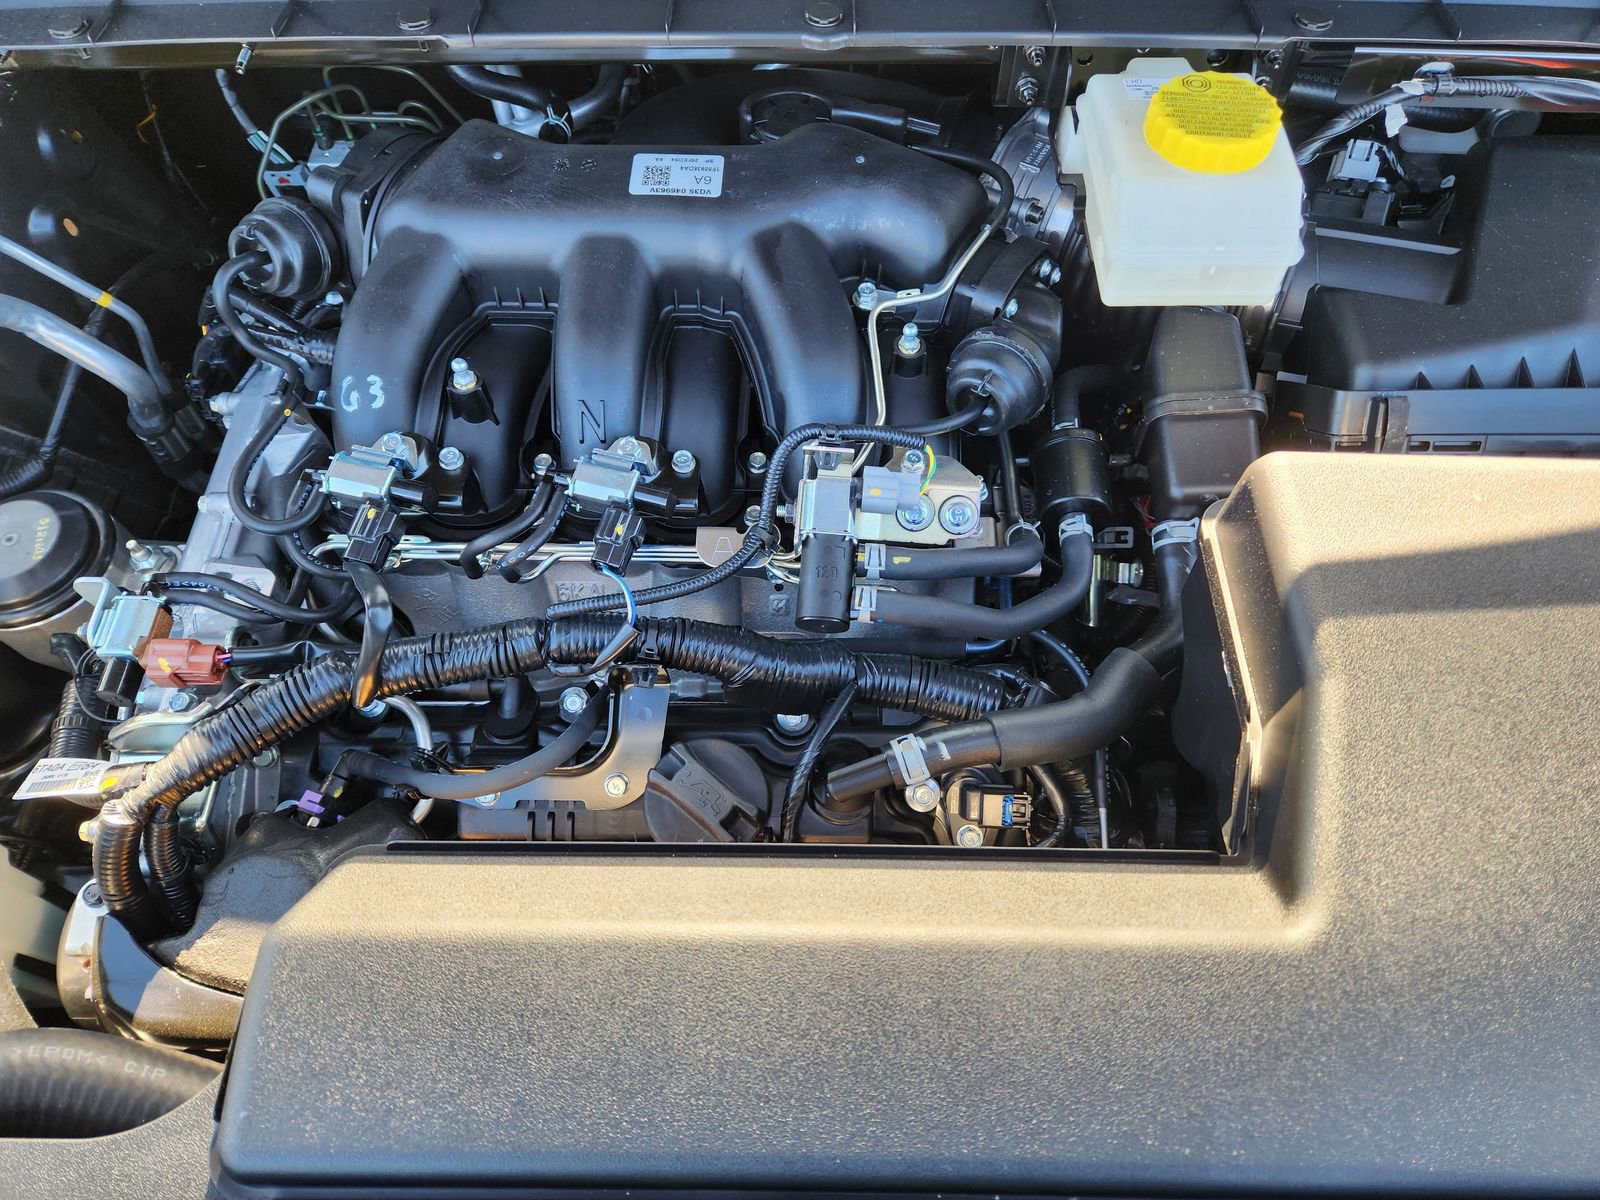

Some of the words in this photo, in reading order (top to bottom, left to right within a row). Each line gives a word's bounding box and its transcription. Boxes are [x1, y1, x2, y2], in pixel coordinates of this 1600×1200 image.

[693, 175, 712, 185] 6A
[577, 399, 606, 444] N
[711, 537, 735, 562] A
